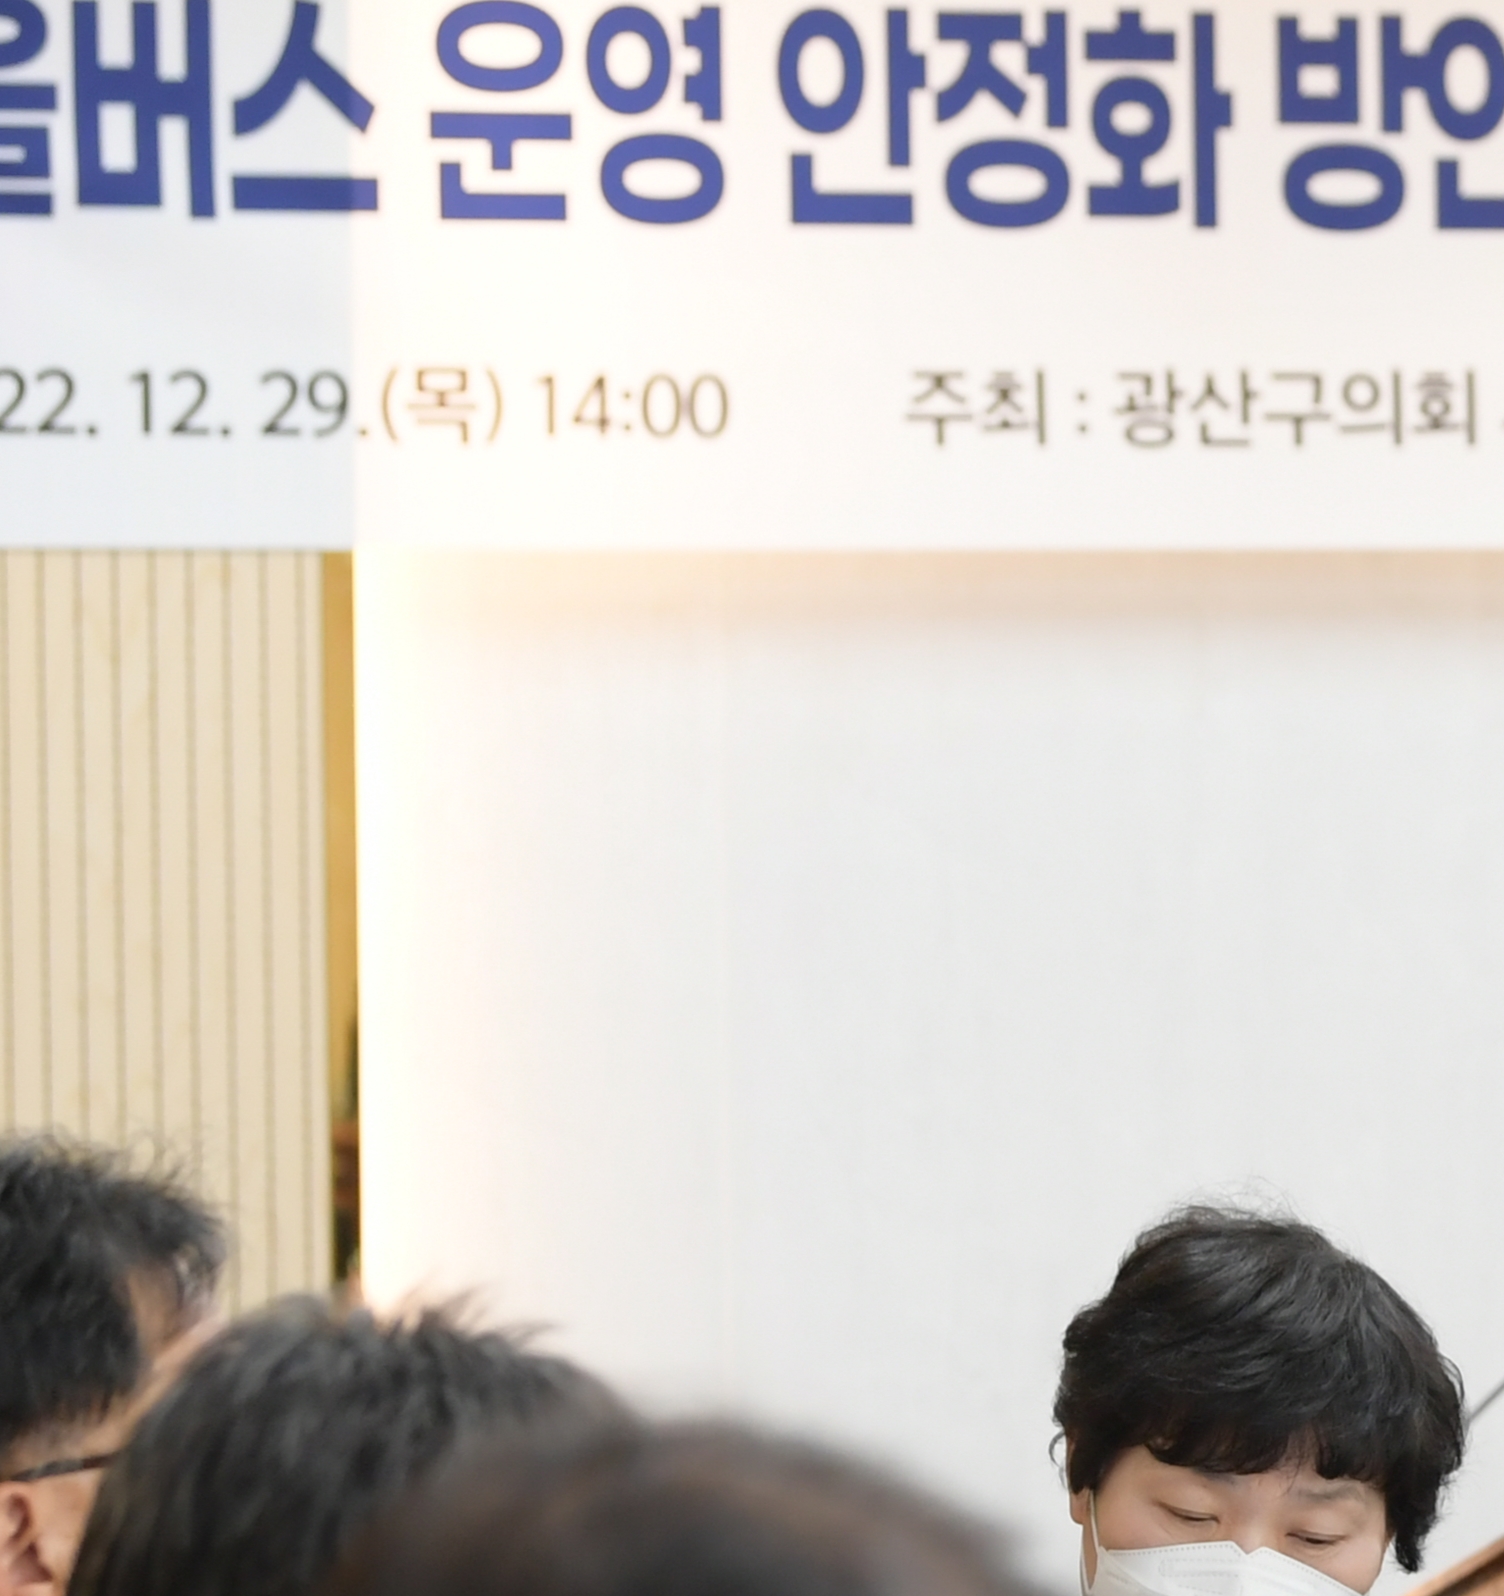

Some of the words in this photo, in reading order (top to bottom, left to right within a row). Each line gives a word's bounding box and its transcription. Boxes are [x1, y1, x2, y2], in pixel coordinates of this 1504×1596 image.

[430, 0, 726, 226] 운영
[777, 7, 1235, 230] 안정화
[130, 369, 232, 437] 12.
[538, 372, 730, 438] 14:00
[906, 370, 1047, 446] 주최
[1114, 370, 1477, 448] 광산구의회
